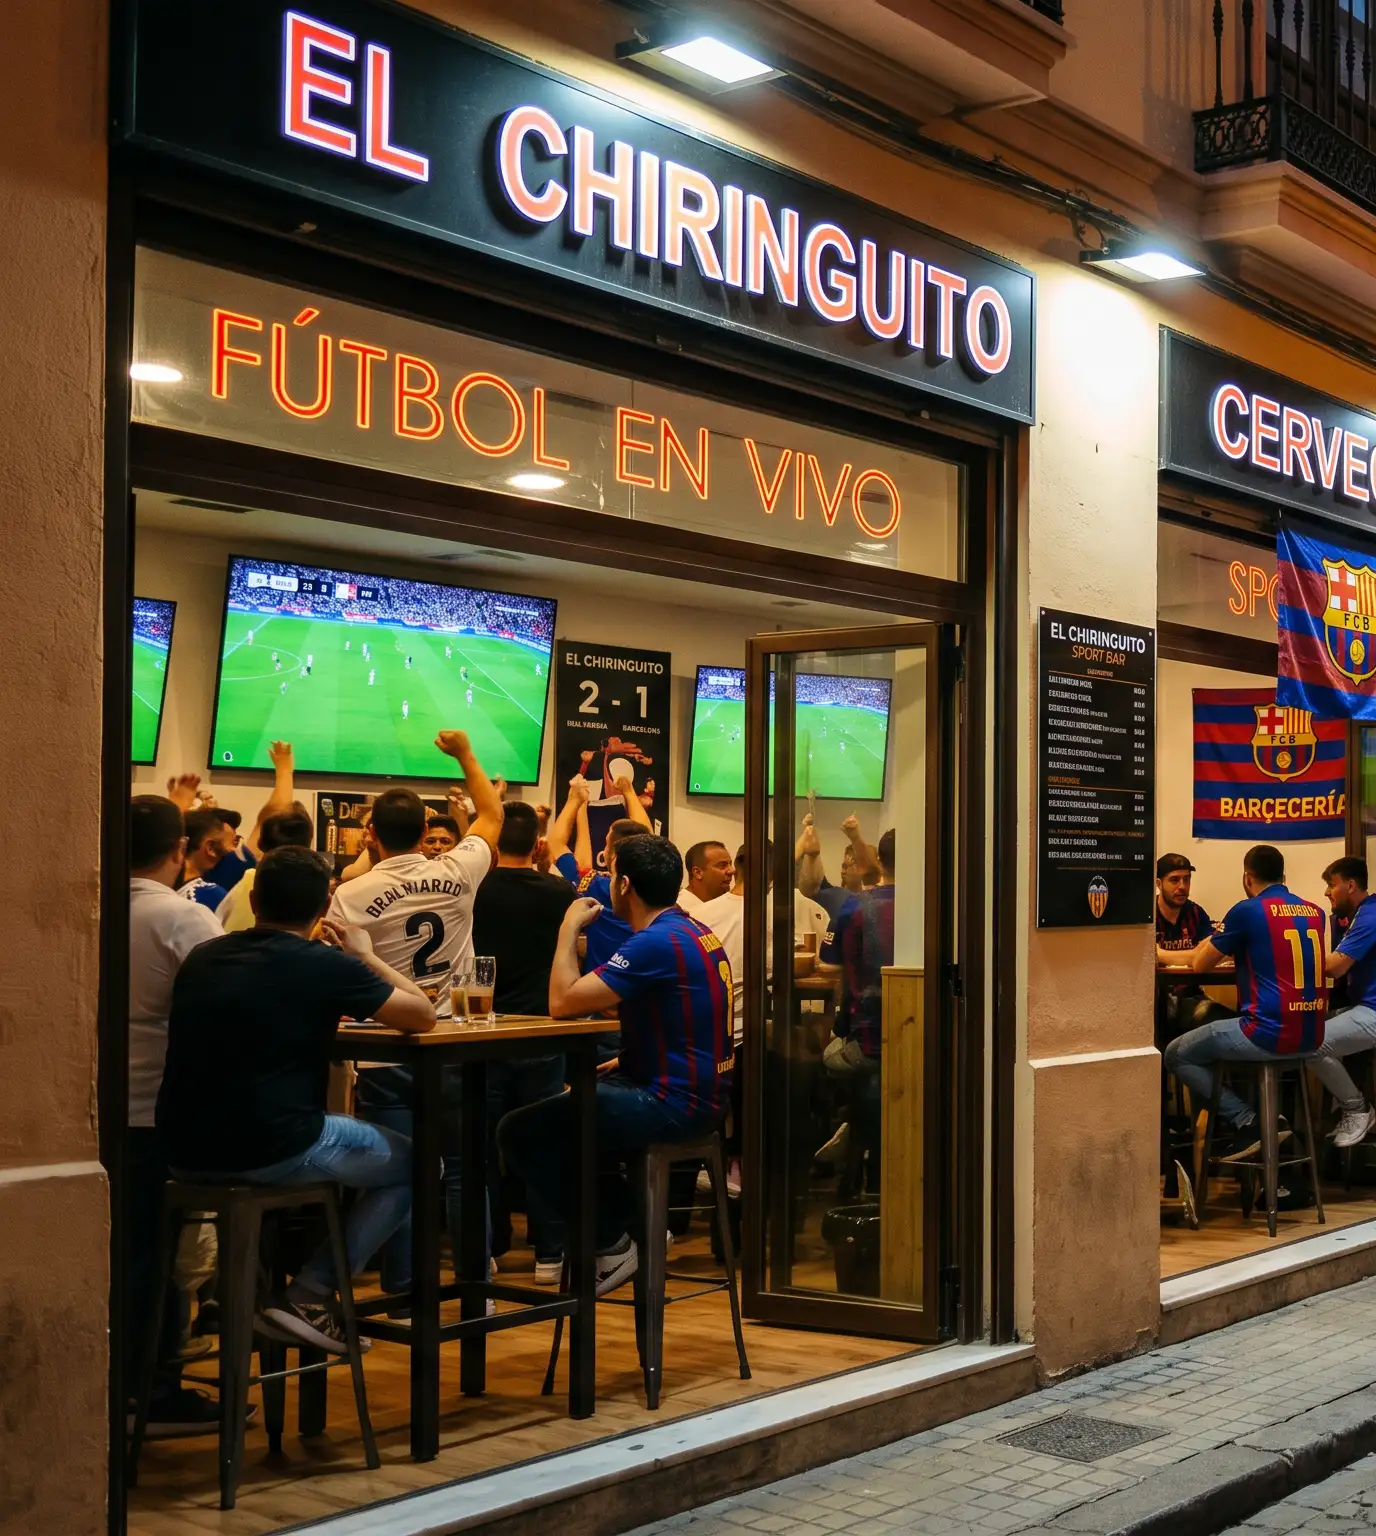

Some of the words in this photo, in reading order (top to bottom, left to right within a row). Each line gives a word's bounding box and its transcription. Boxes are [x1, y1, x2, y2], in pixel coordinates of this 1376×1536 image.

[282, 9, 430, 183] EL
[497, 104, 1014, 377] CHIRINGUITO
[211, 306, 571, 472] FÚTBOL
[614, 406, 710, 501] EN
[742, 437, 904, 540] VIVO
[1050, 621, 1066, 640] EL
[1068, 625, 1146, 654] CHIRINGUITO
[1343, 613, 1370, 632] FCB
[566, 652, 581, 666] EL
[584, 655, 664, 674] CHIRINGUITO
[1071, 645, 1106, 662] SPORT
[1105, 651, 1126, 666] BAR
[579, 680, 599, 714] 2
[636, 686, 648, 719] 1
[1270, 735, 1297, 745] FCB
[404, 911, 451, 979] 2
[1283, 928, 1323, 989] 11
